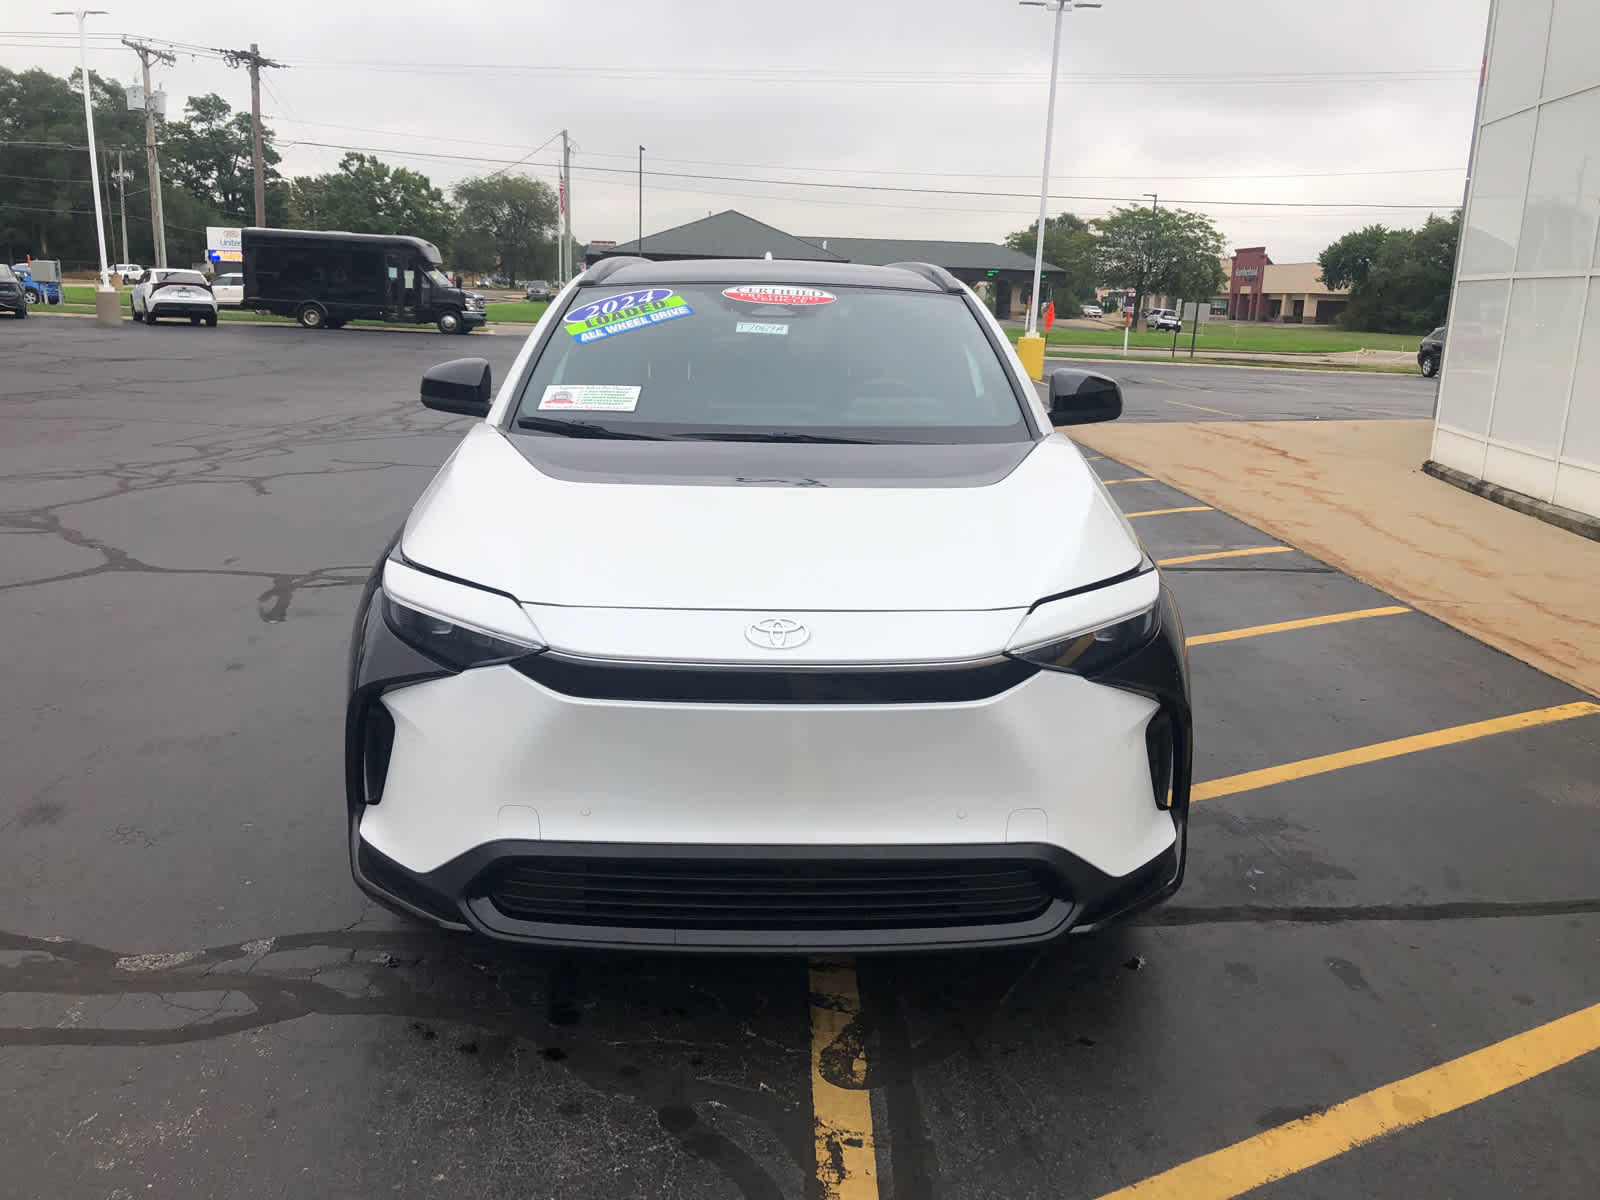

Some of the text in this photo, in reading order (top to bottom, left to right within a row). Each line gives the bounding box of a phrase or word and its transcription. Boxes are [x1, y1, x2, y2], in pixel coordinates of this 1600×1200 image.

[585, 290, 654, 319] 2024
[736, 287, 824, 297] CERTIFIED
[580, 305, 692, 342] ALL WHEEL DRIVE
[585, 300, 667, 328] LOADED
